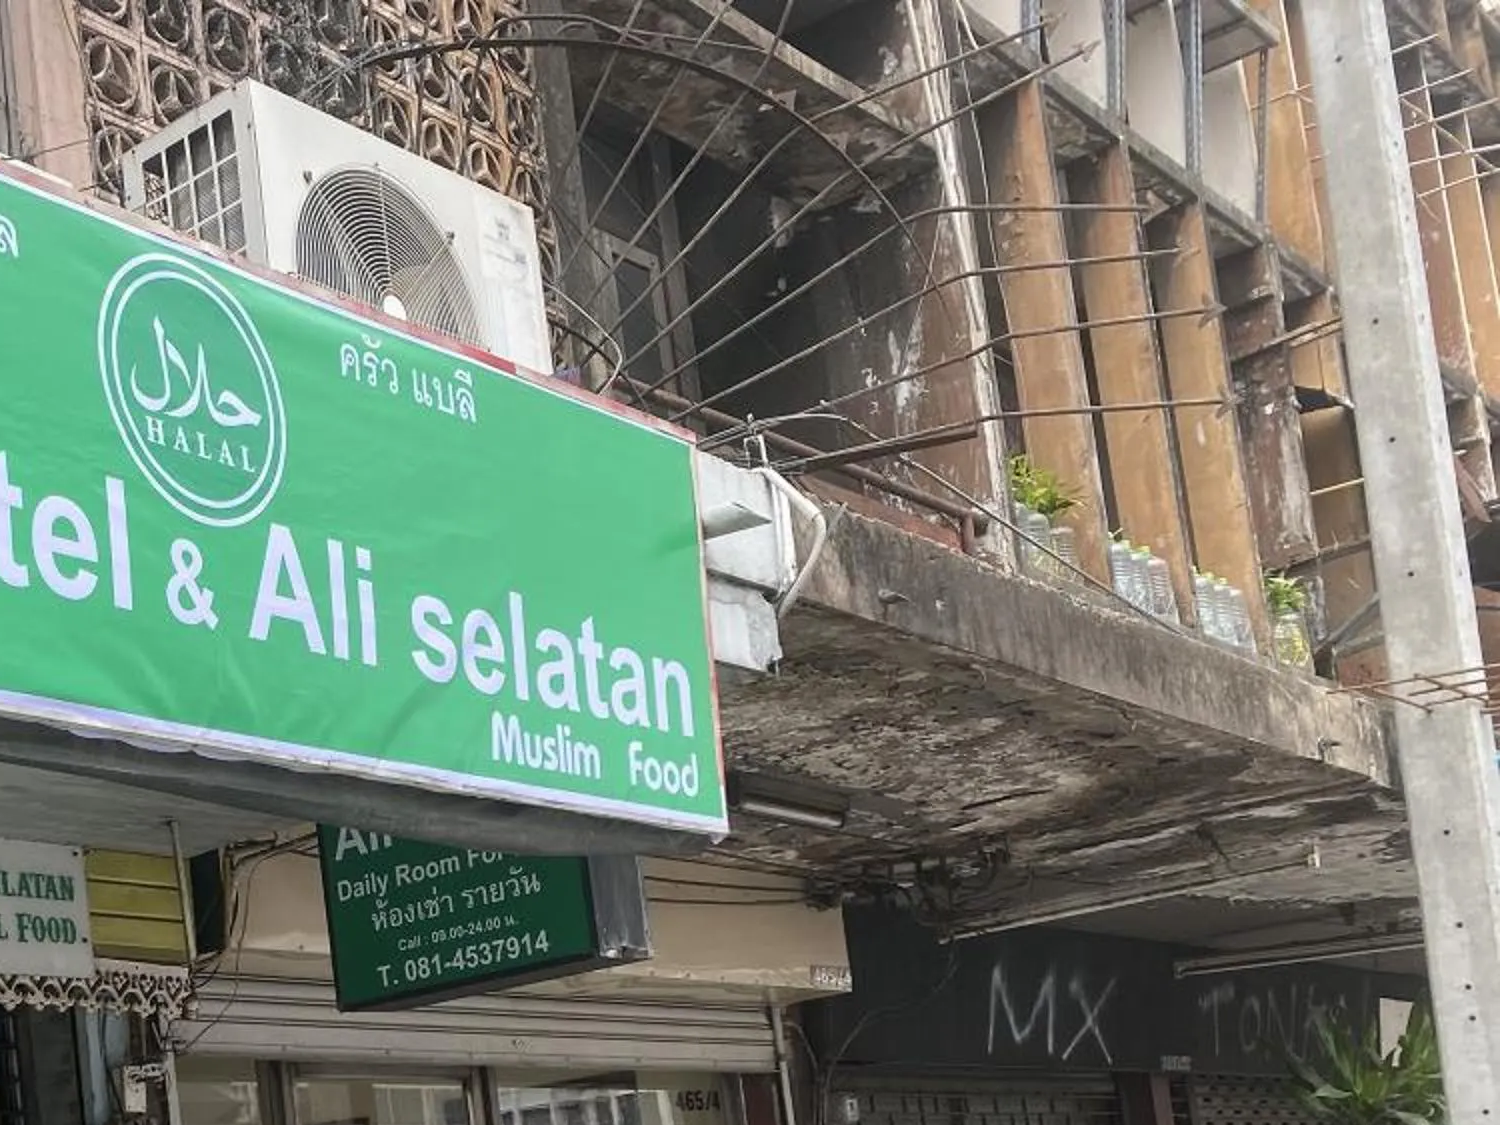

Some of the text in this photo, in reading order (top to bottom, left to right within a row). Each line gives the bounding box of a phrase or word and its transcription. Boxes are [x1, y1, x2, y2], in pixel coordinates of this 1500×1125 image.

[130, 315, 262, 427] حلال
[340, 334, 477, 423] ครัว แบลี
[145, 416, 255, 473] HALAL
[166, 538, 218, 630] &
[250, 524, 377, 666] Ali
[411, 591, 694, 737] selatan
[491, 712, 698, 798] Muslim Food
[338, 872, 389, 901] Daily
[395, 856, 461, 887] Room
[371, 866, 541, 932] ห้องเช่า รายวัน
[15, 913, 77, 944] FOOD
[376, 929, 549, 988] T. 081-4537914
[987, 963, 1116, 1065] MX
